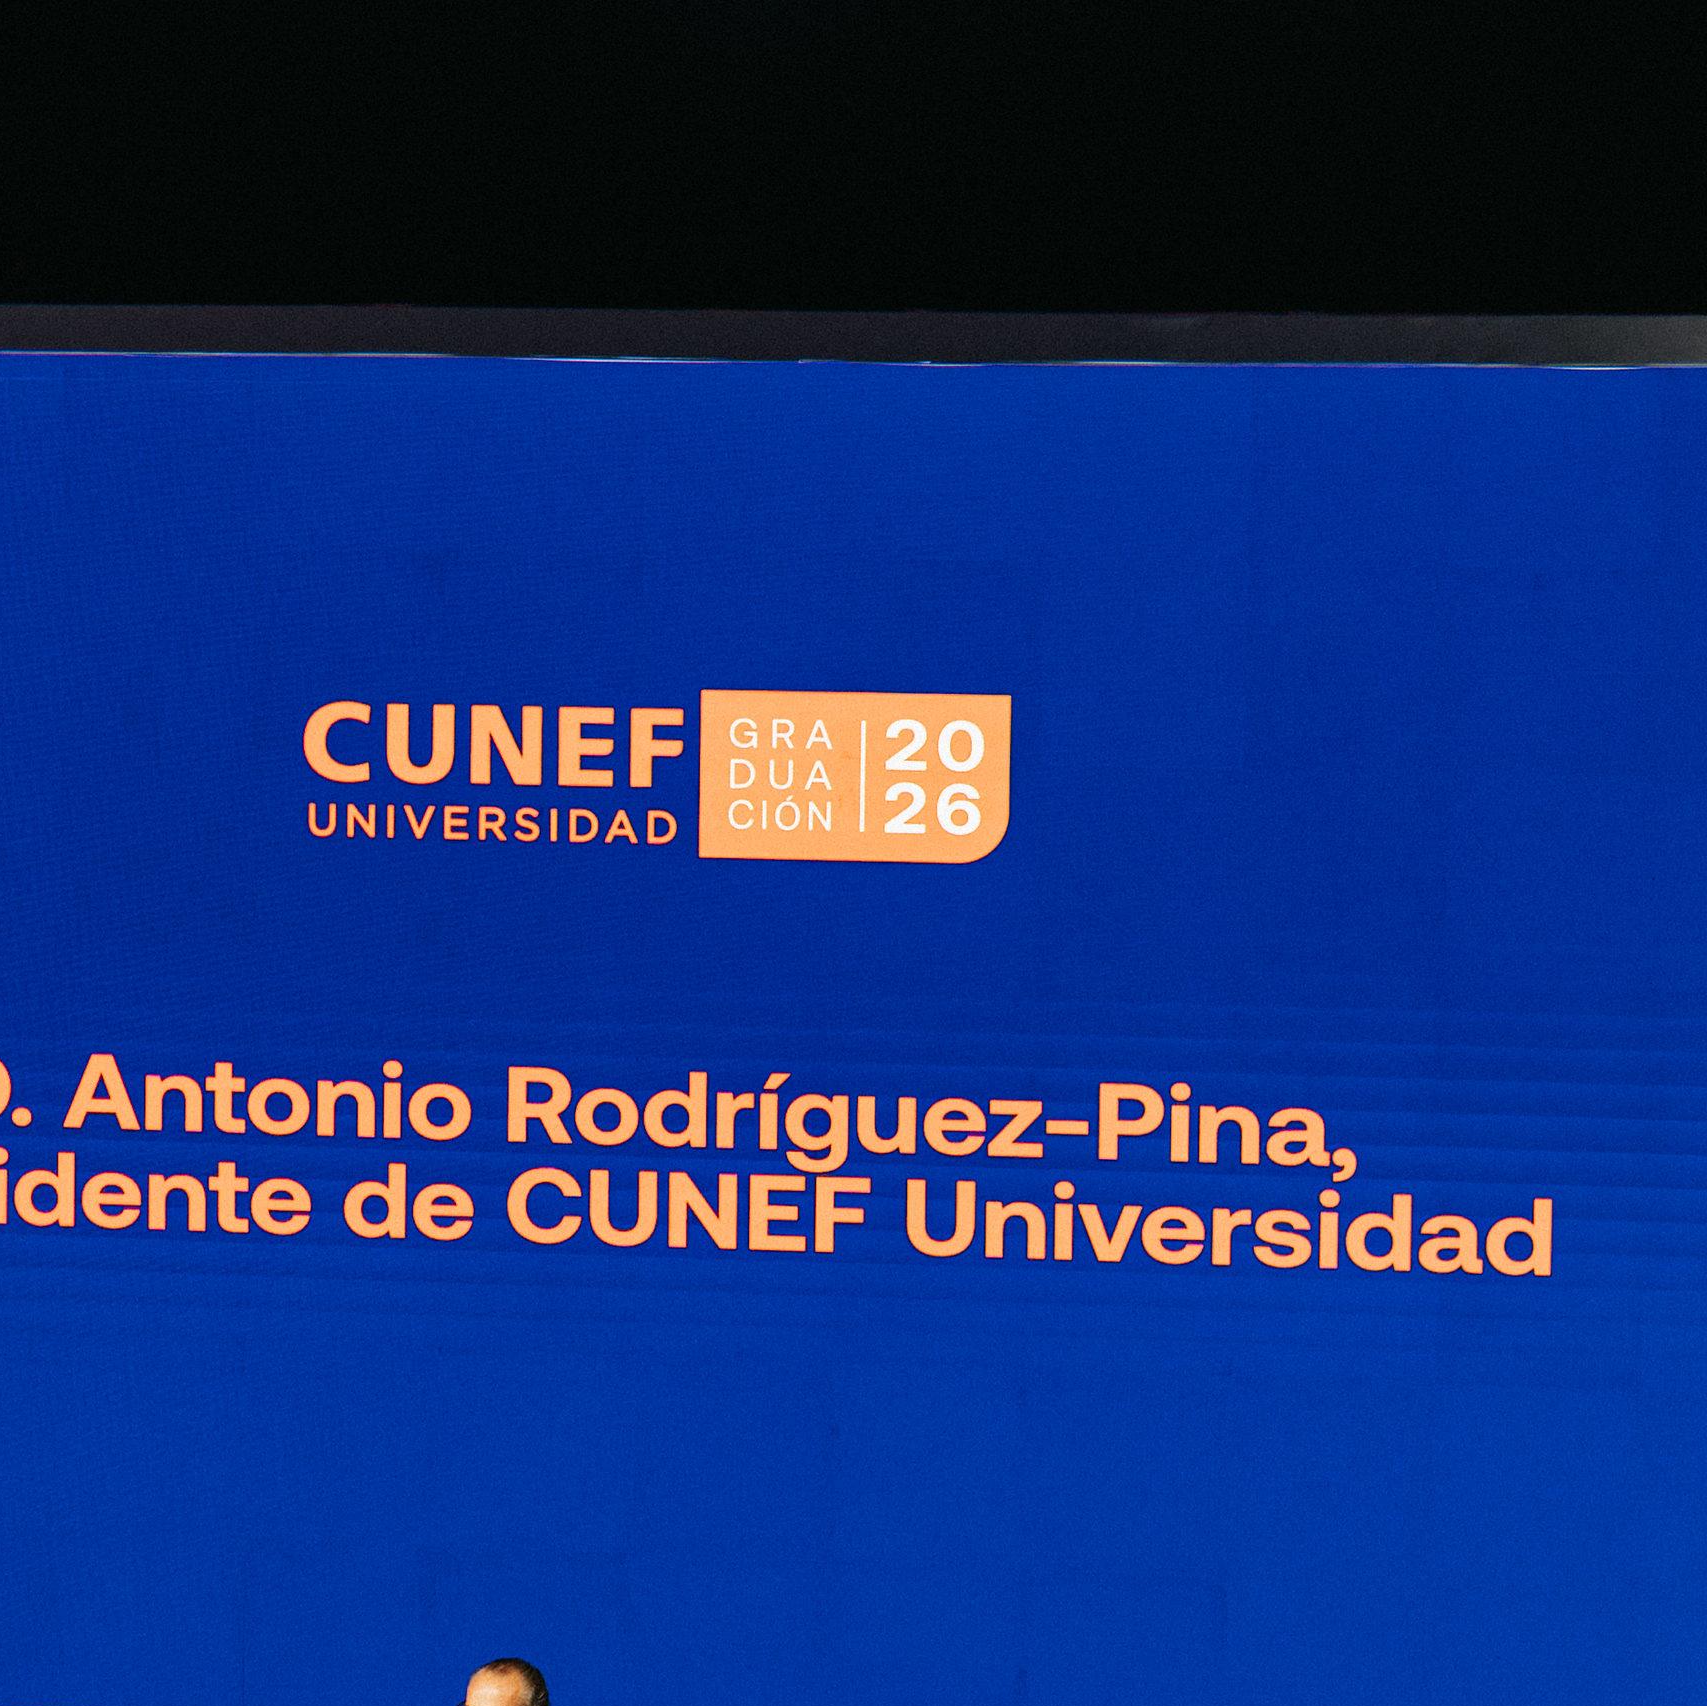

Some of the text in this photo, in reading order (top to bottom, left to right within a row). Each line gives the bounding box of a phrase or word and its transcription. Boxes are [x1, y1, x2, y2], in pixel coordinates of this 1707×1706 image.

[304, 701, 684, 788] CUNEF
[729, 718, 833, 750] GRA
[885, 719, 985, 772] 20
[729, 758, 832, 791] DUA
[308, 803, 678, 845] UNIVERSIDAD
[728, 796, 832, 832] CIÓN
[884, 782, 982, 836] 26
[63, 1054, 472, 1141] Antonio
[507, 1066, 1357, 1183] Rodríguez-Pina,
[343, 1162, 474, 1241] de
[506, 1167, 872, 1253] CUNEF
[906, 1178, 1553, 1277] Universidad
